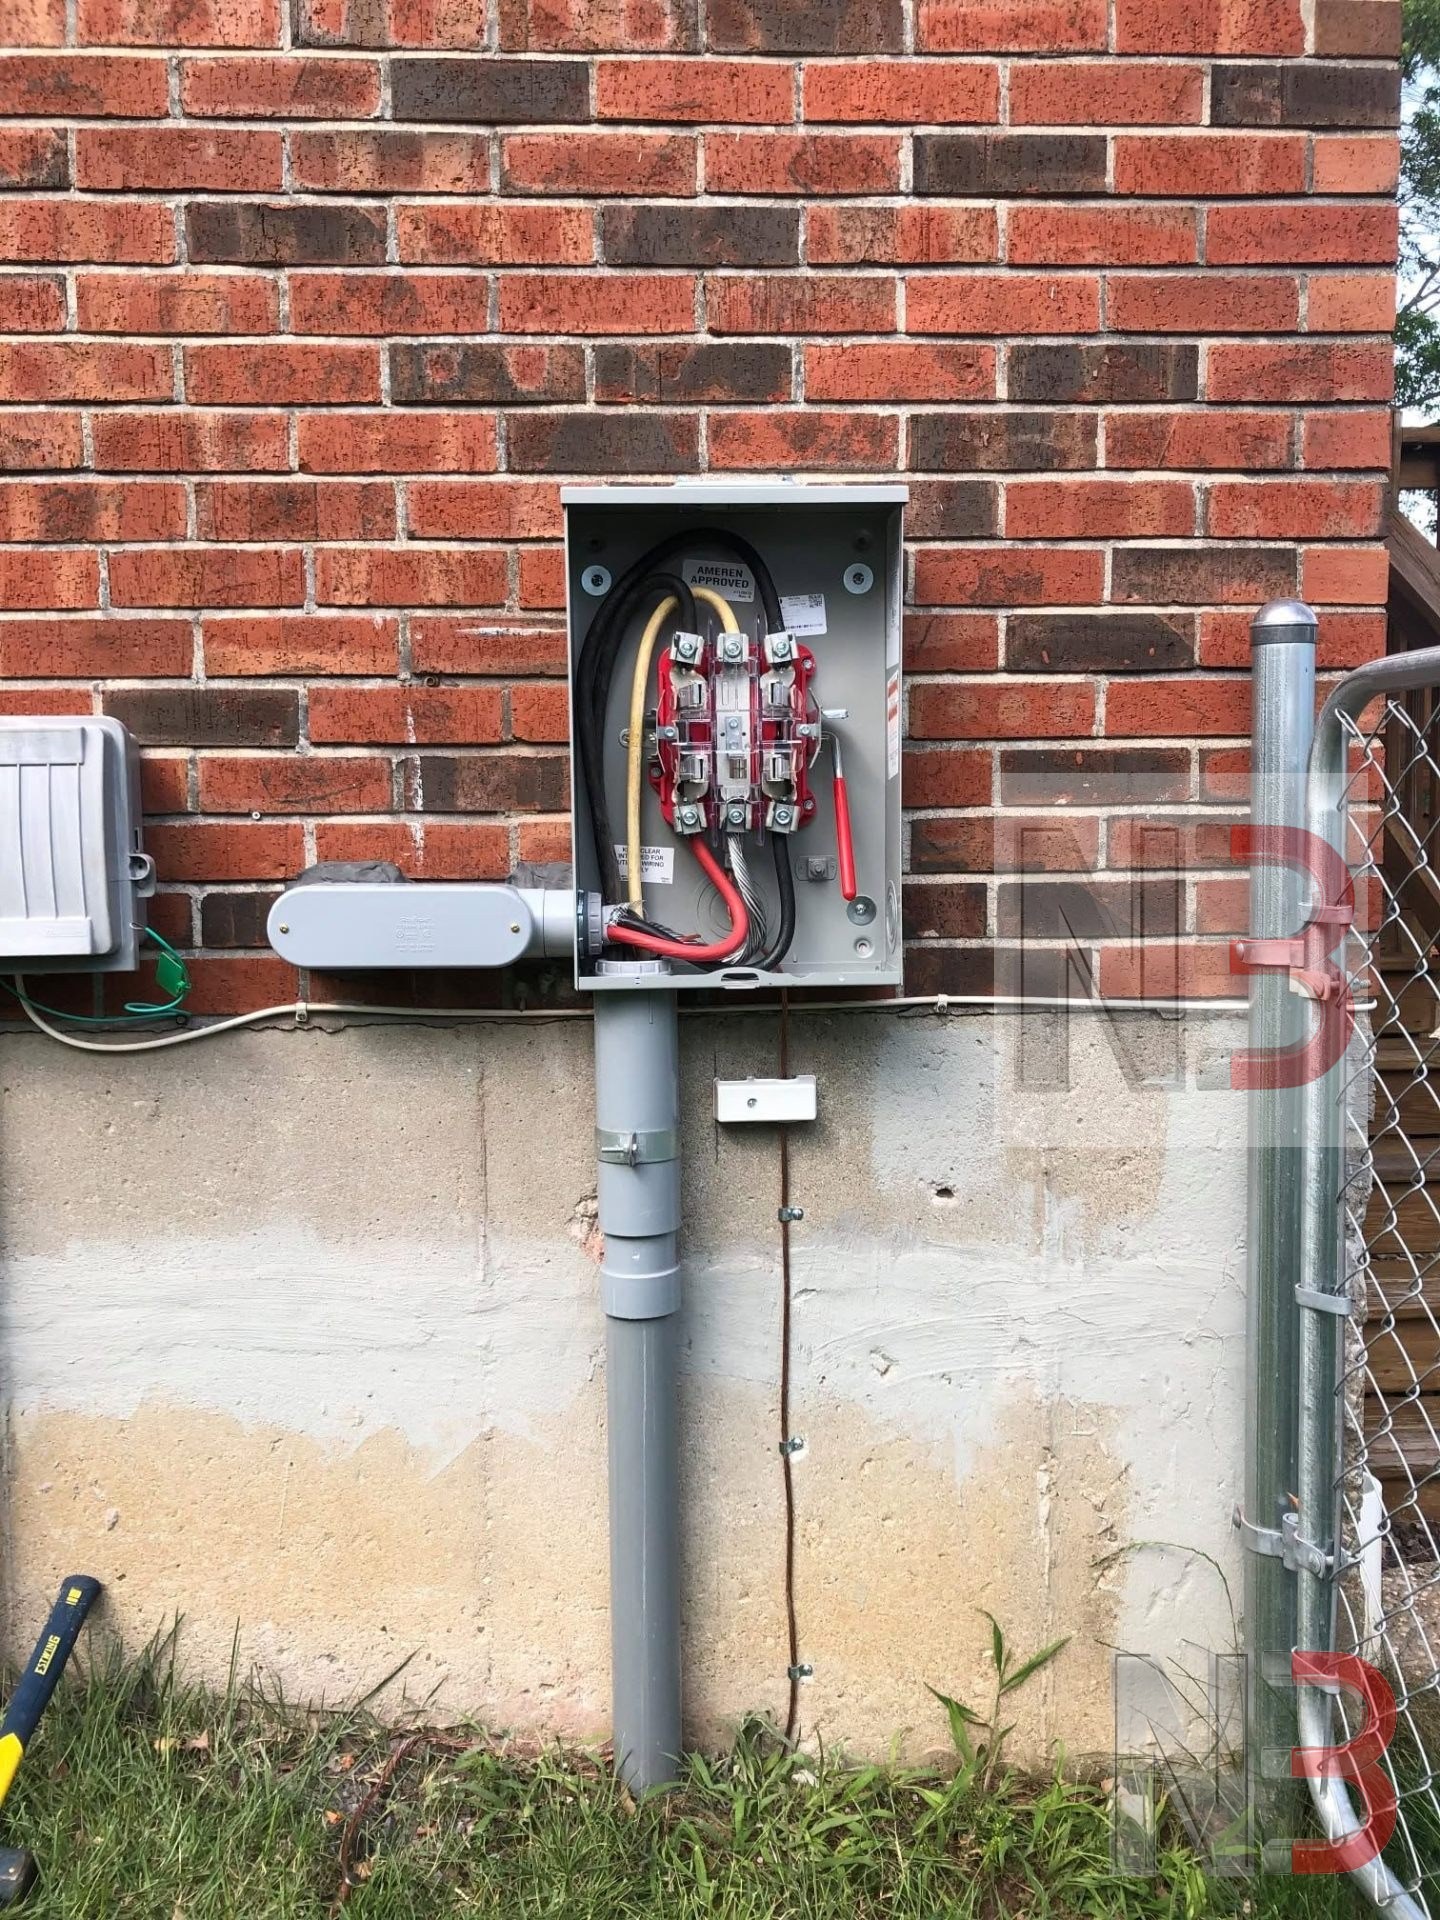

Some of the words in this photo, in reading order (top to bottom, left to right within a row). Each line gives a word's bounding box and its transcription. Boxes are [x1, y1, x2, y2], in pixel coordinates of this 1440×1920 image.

[697, 566, 743, 578] AMEREN
[690, 576, 749, 588] APPROVED
[35, 1634, 60, 1674] ESTWING
